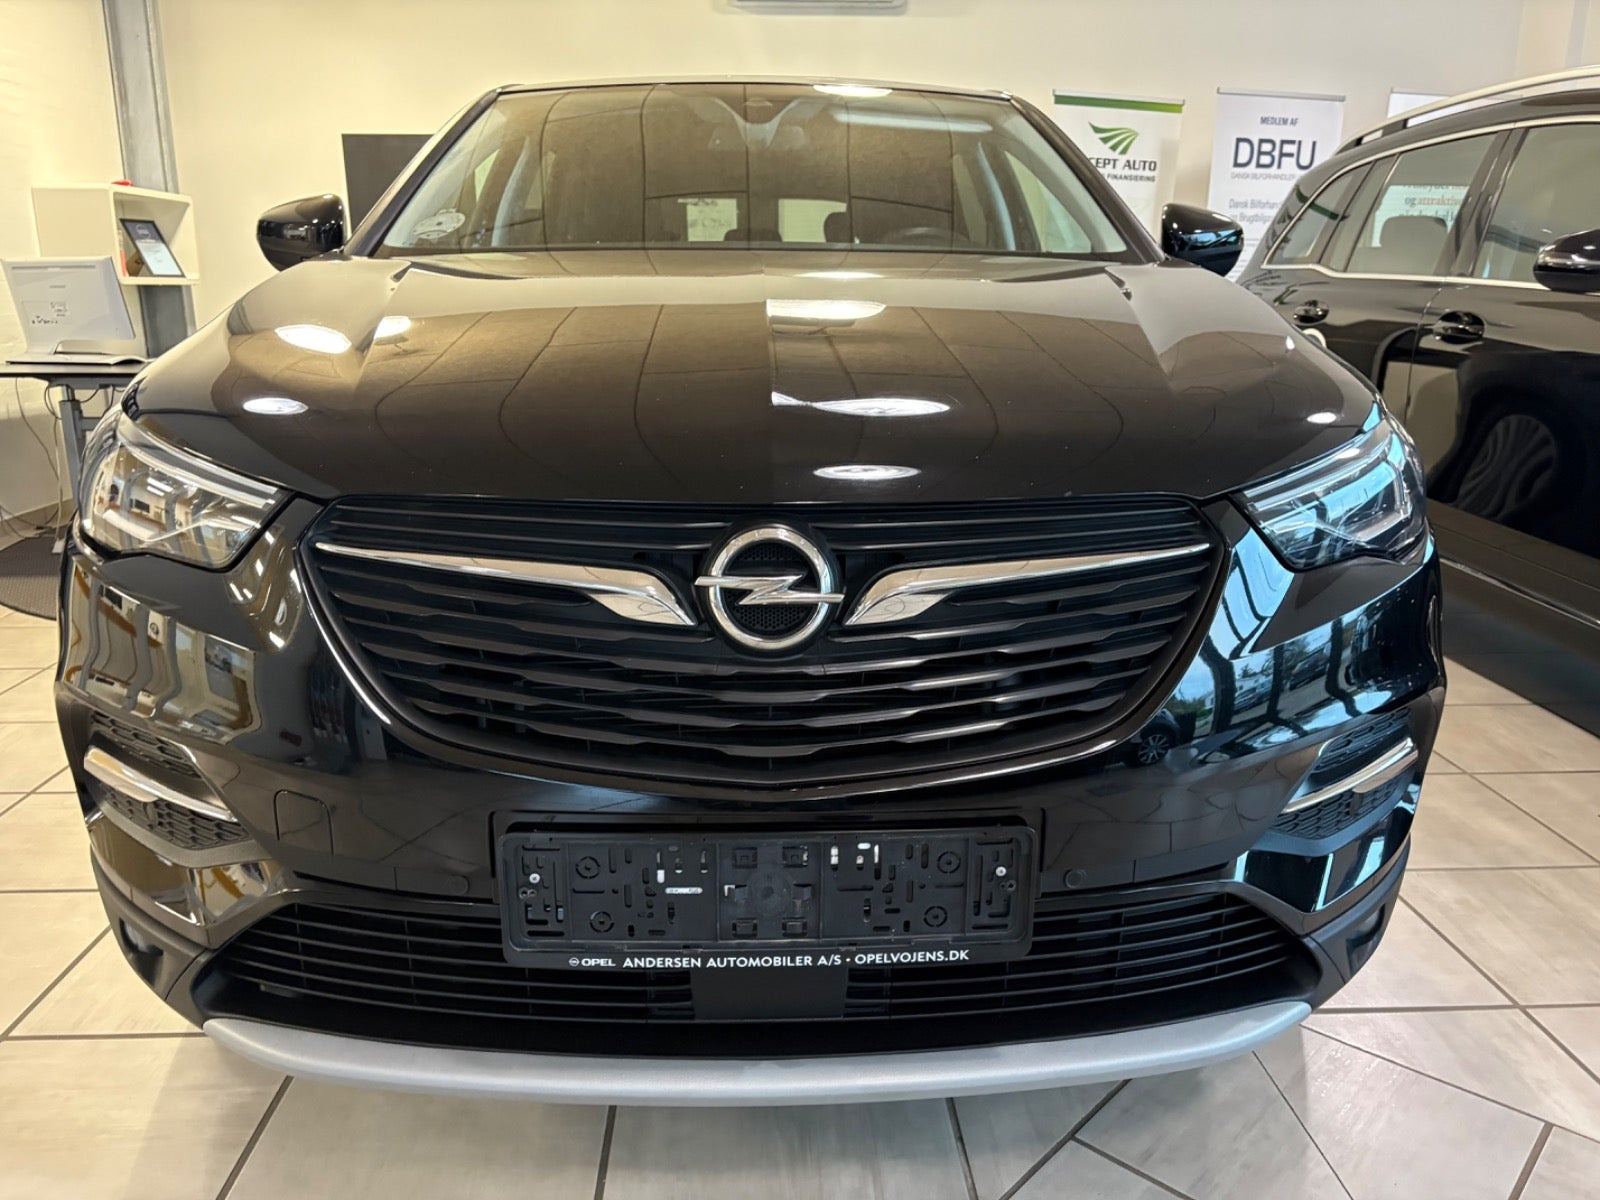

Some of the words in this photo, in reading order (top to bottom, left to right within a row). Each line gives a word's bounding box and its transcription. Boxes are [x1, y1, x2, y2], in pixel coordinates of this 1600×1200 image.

[1260, 116, 1289, 126] MEDLEM
[1289, 117, 1299, 126] AF
[1232, 137, 1317, 171] DBFU
[1122, 159, 1157, 172] AUTO
[1106, 173, 1156, 182] FINANSIERING
[1404, 197, 1417, 208] og
[581, 958, 617, 967] OPEL
[623, 956, 702, 968] ANDERSEN
[706, 955, 813, 968] AUTOMOBILER
[817, 953, 842, 967] A/S
[854, 949, 970, 965] OPELVOJENS.DK
